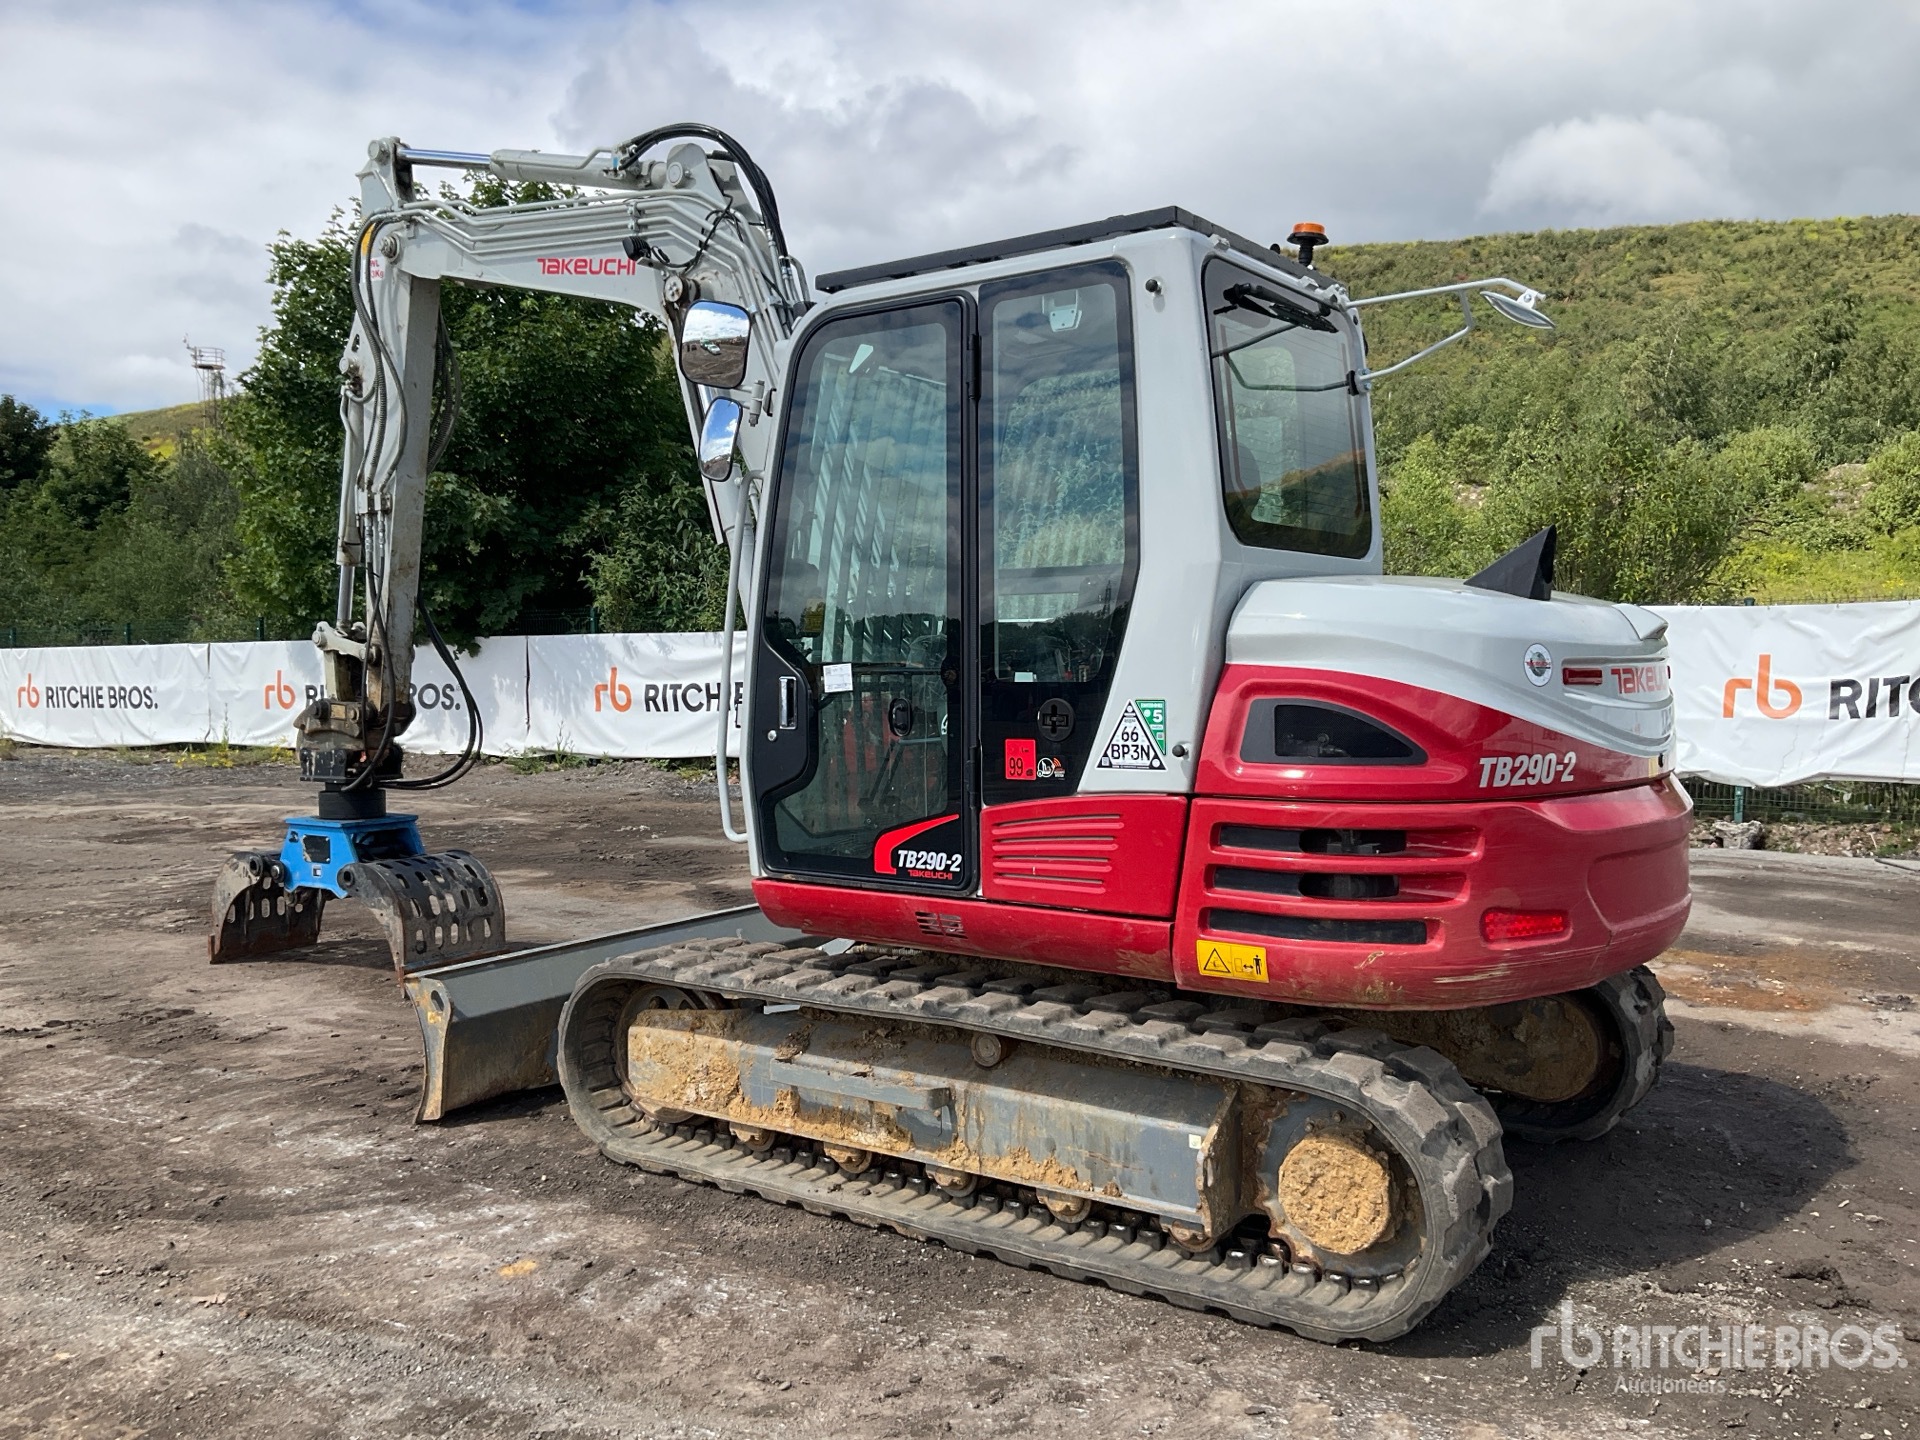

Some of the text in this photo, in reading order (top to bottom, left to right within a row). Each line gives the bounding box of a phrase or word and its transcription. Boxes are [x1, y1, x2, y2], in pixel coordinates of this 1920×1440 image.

[537, 258, 637, 275] TAKEUCHI
[1723, 654, 1803, 719] rb
[45, 686, 105, 709] RITCHIE
[108, 686, 159, 709] BROS.
[1152, 709, 1163, 723] 5
[1121, 726, 1139, 742] 66
[1111, 744, 1150, 760] BP3N
[1009, 757, 1024, 776] 99
[1479, 751, 1577, 788] TB290-2
[898, 850, 962, 872] TB290-2
[908, 869, 953, 880] TAKEUCHI
